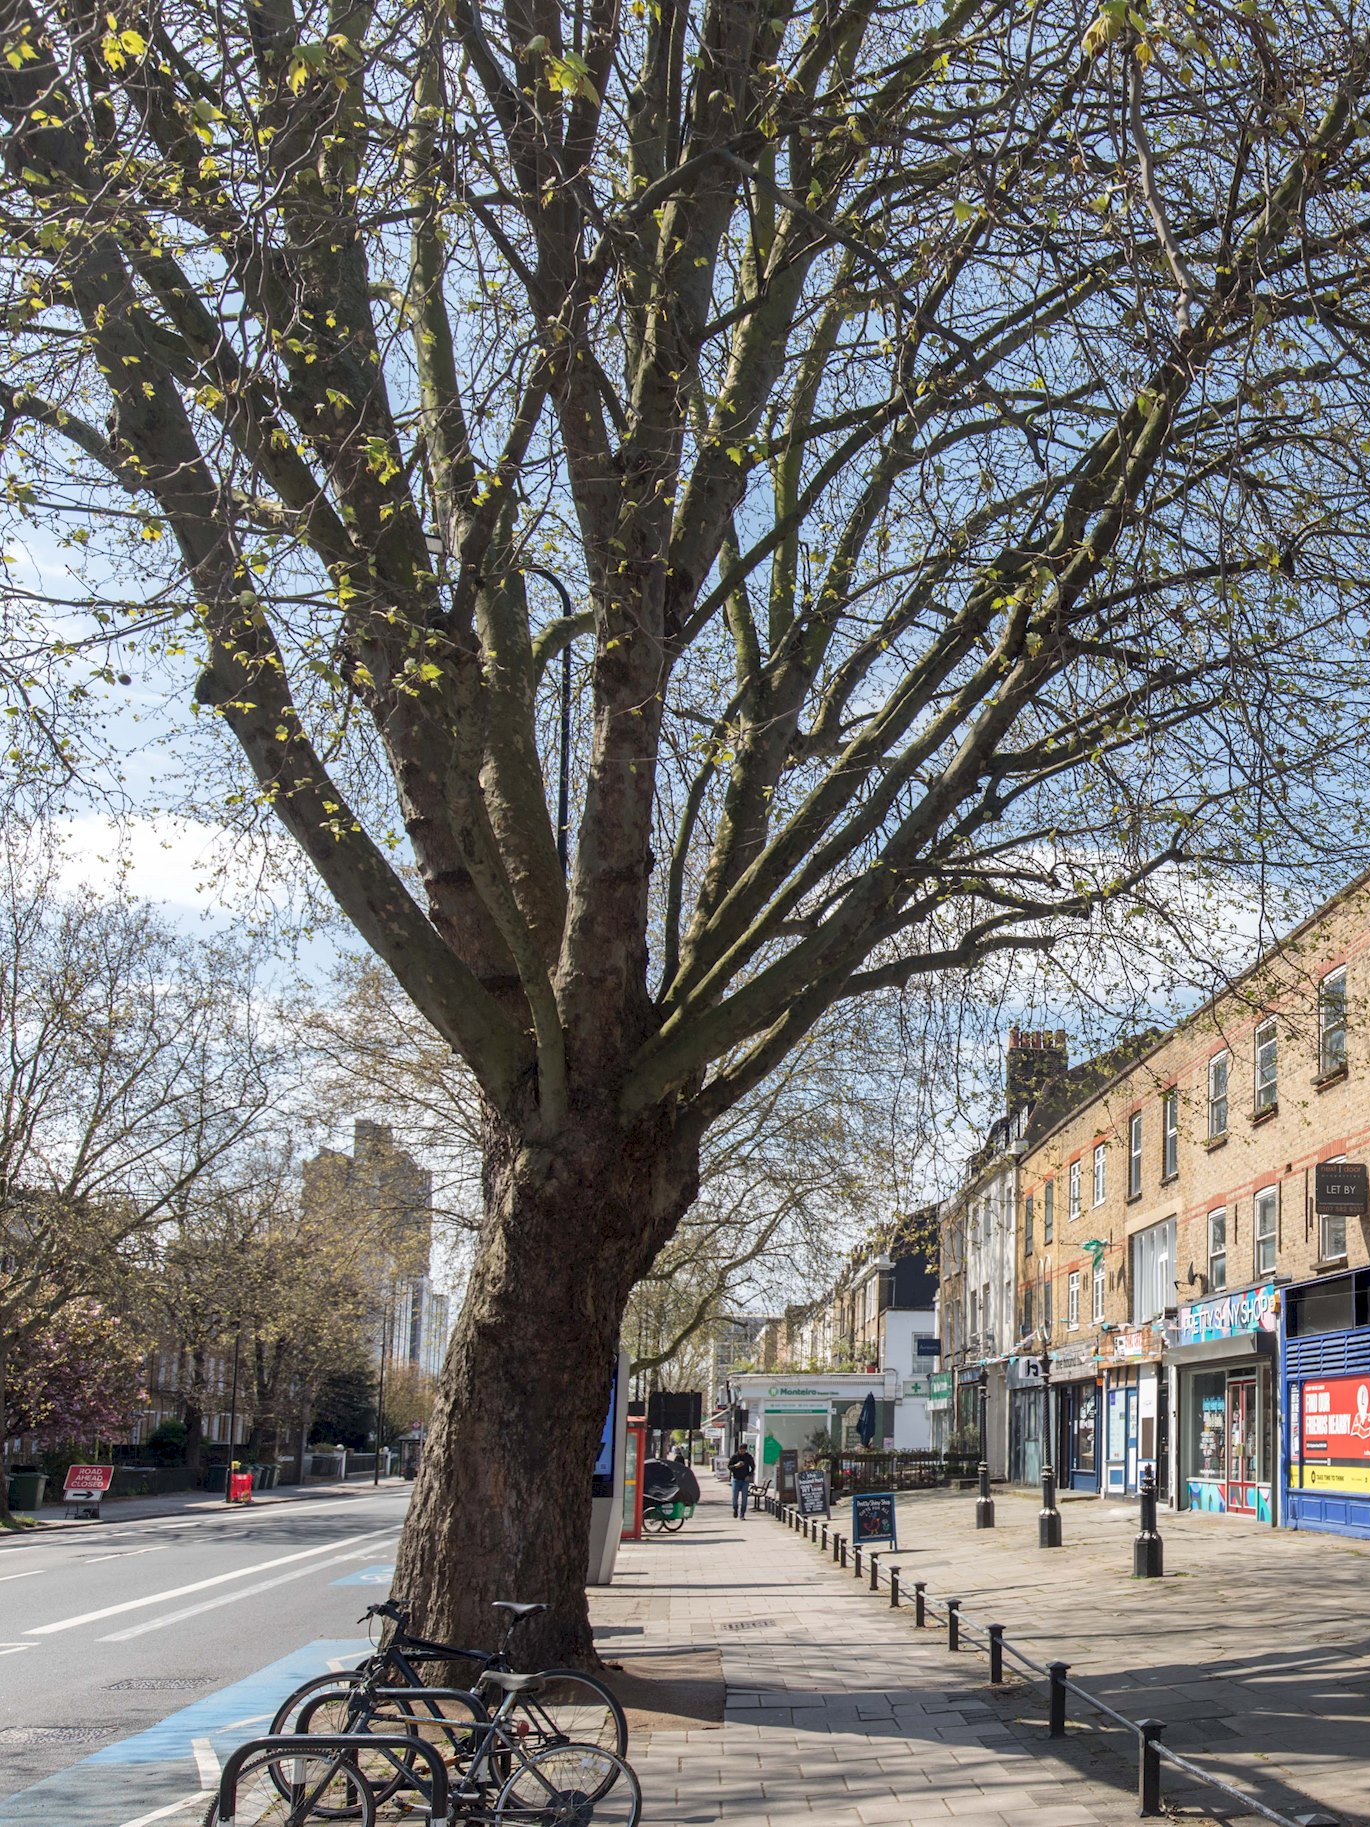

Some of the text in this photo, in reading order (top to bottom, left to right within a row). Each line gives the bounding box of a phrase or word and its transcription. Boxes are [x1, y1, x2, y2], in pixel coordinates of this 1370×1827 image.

[1326, 1185, 1356, 1194] LET BY
[1182, 1296, 1268, 1336] PRETTY SHNY SHOP
[780, 1388, 817, 1396] Monteiro
[1305, 1393, 1318, 1413] FIND
[1318, 1392, 1330, 1412] OUR
[1305, 1414, 1328, 1435] FRIENDS
